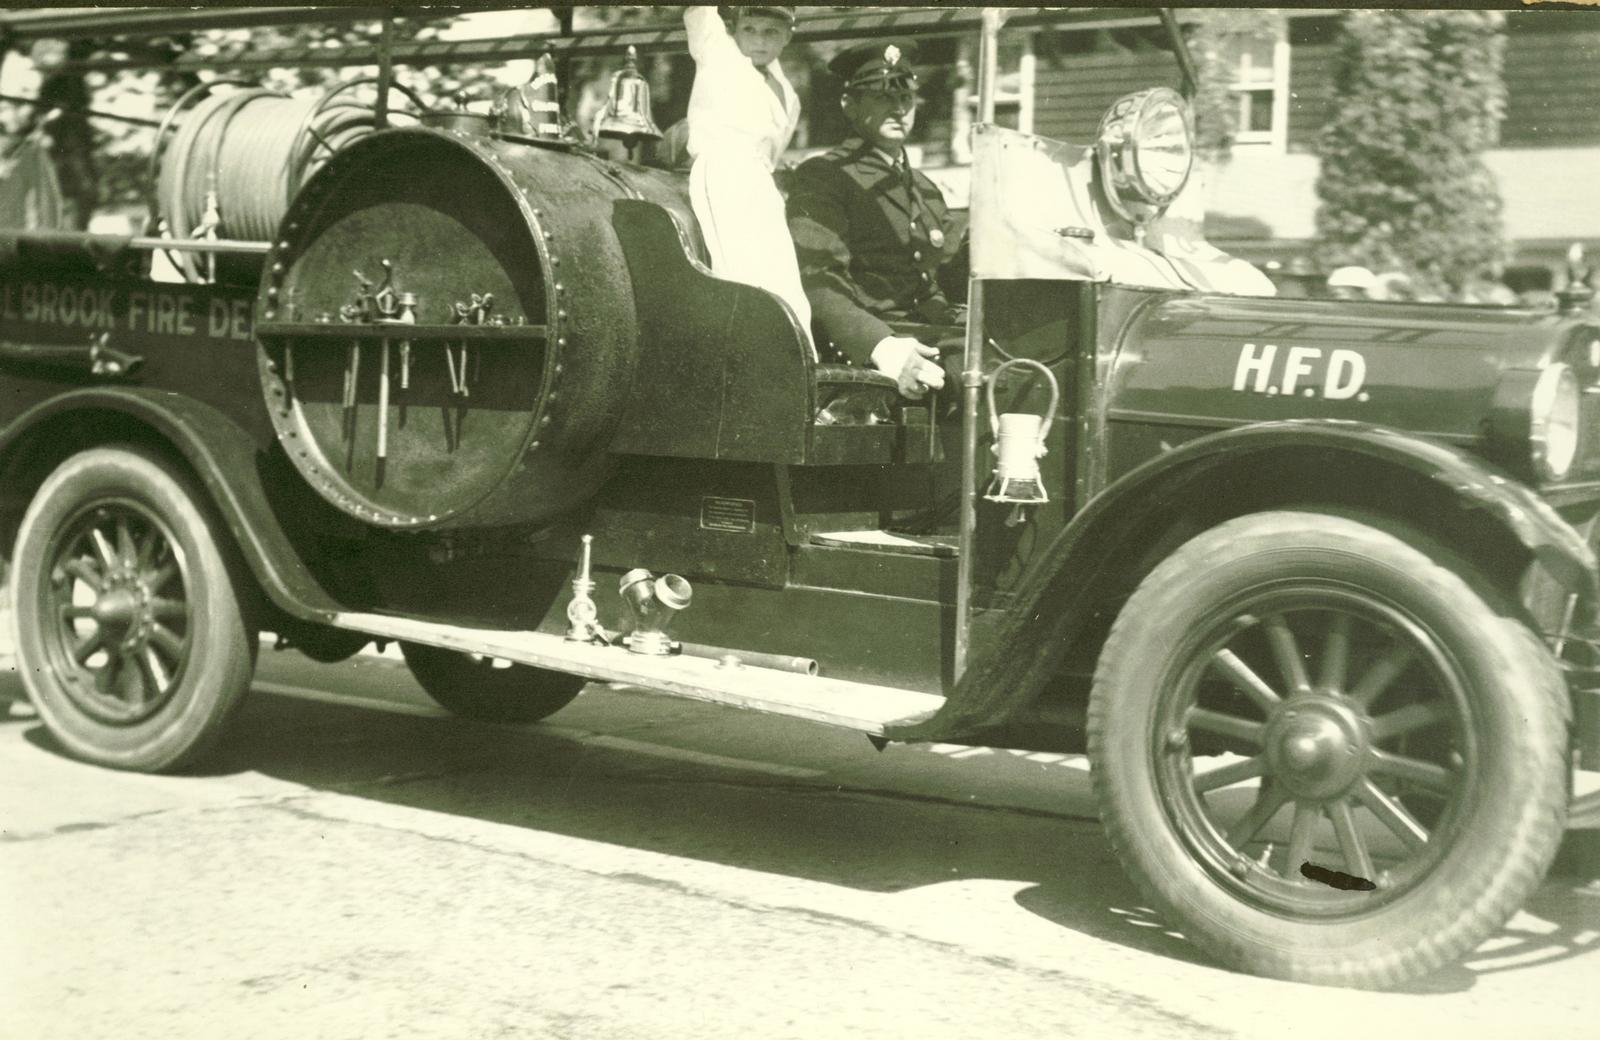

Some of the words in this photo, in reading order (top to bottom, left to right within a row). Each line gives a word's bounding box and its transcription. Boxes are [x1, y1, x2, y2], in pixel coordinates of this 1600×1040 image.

[0, 283, 117, 329] LBROOK
[128, 292, 197, 336] FIRE
[1233, 343, 1370, 402] H.F.D.
